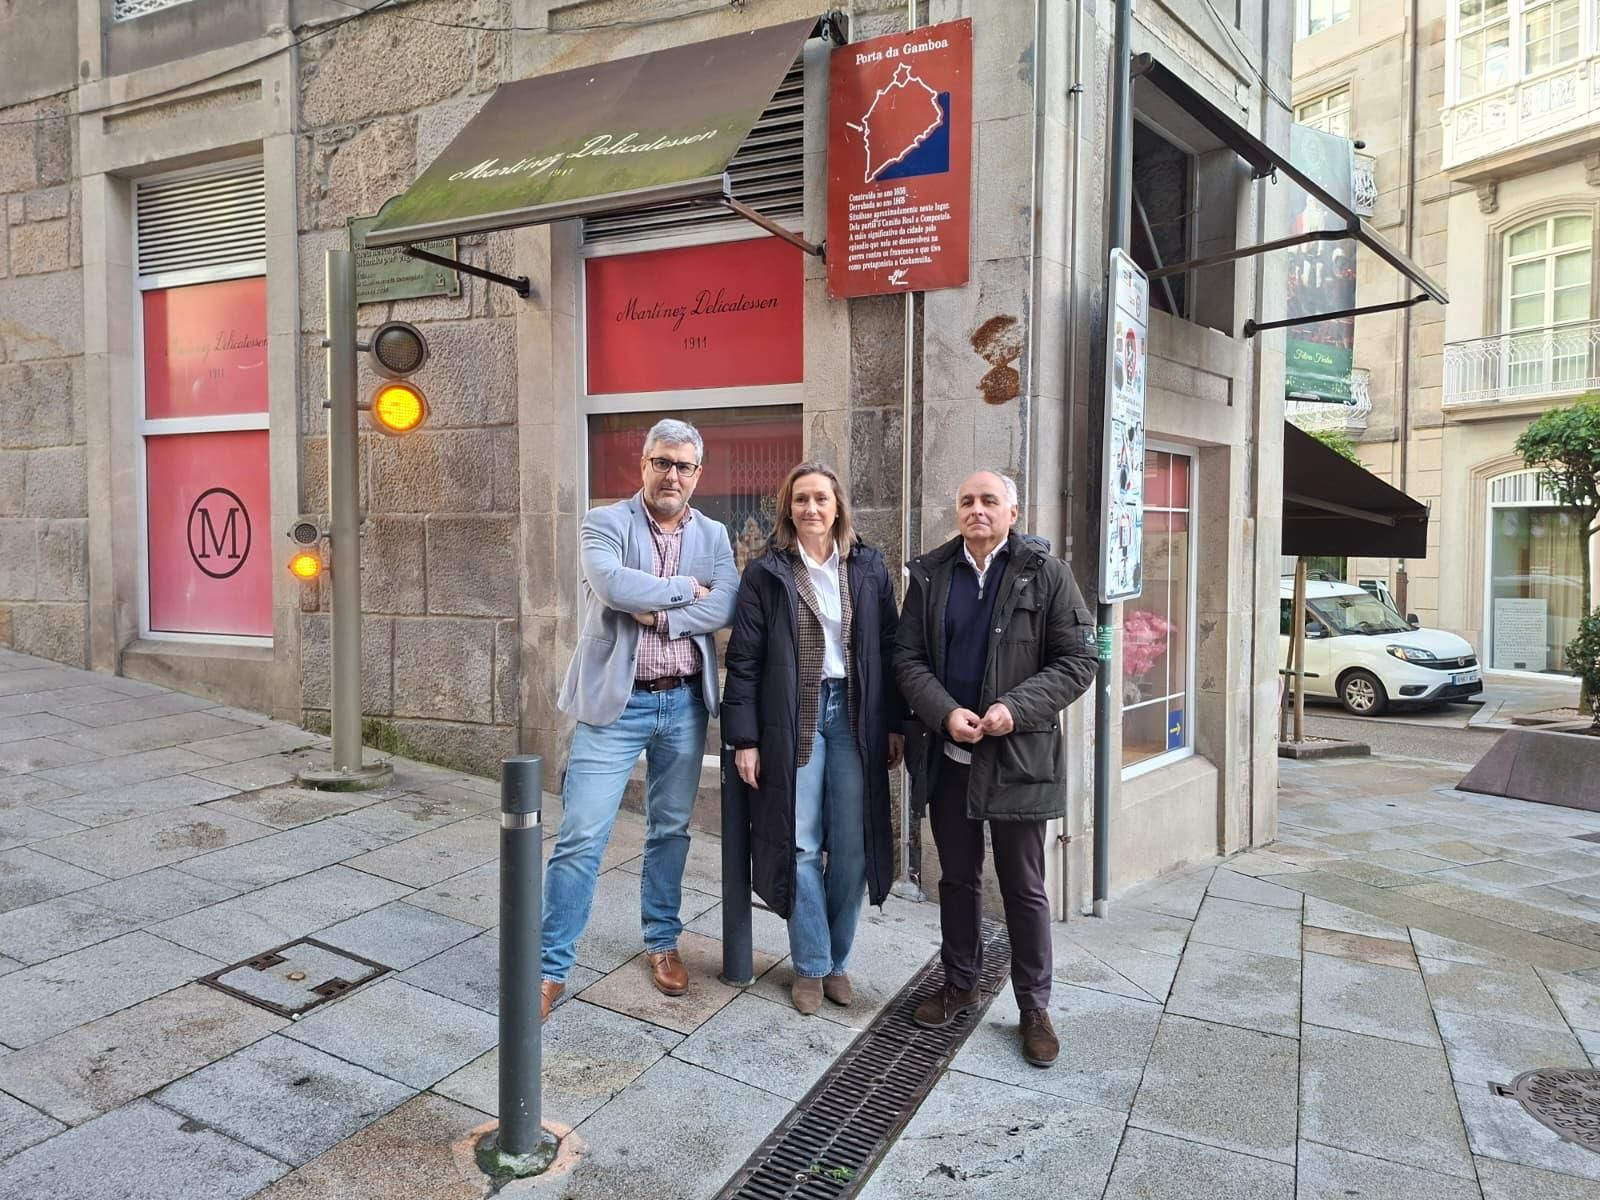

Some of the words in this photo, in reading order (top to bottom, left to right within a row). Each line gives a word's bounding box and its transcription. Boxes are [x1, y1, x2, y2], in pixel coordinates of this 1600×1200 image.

[856, 52, 882, 65] Porta
[885, 46, 899, 58] da
[903, 39, 949, 55] Gamboa
[566, 129, 718, 158] Delicatessen
[690, 287, 778, 316] Delicatessen
[684, 336, 707, 350] 1911
[197, 507, 241, 559] M
